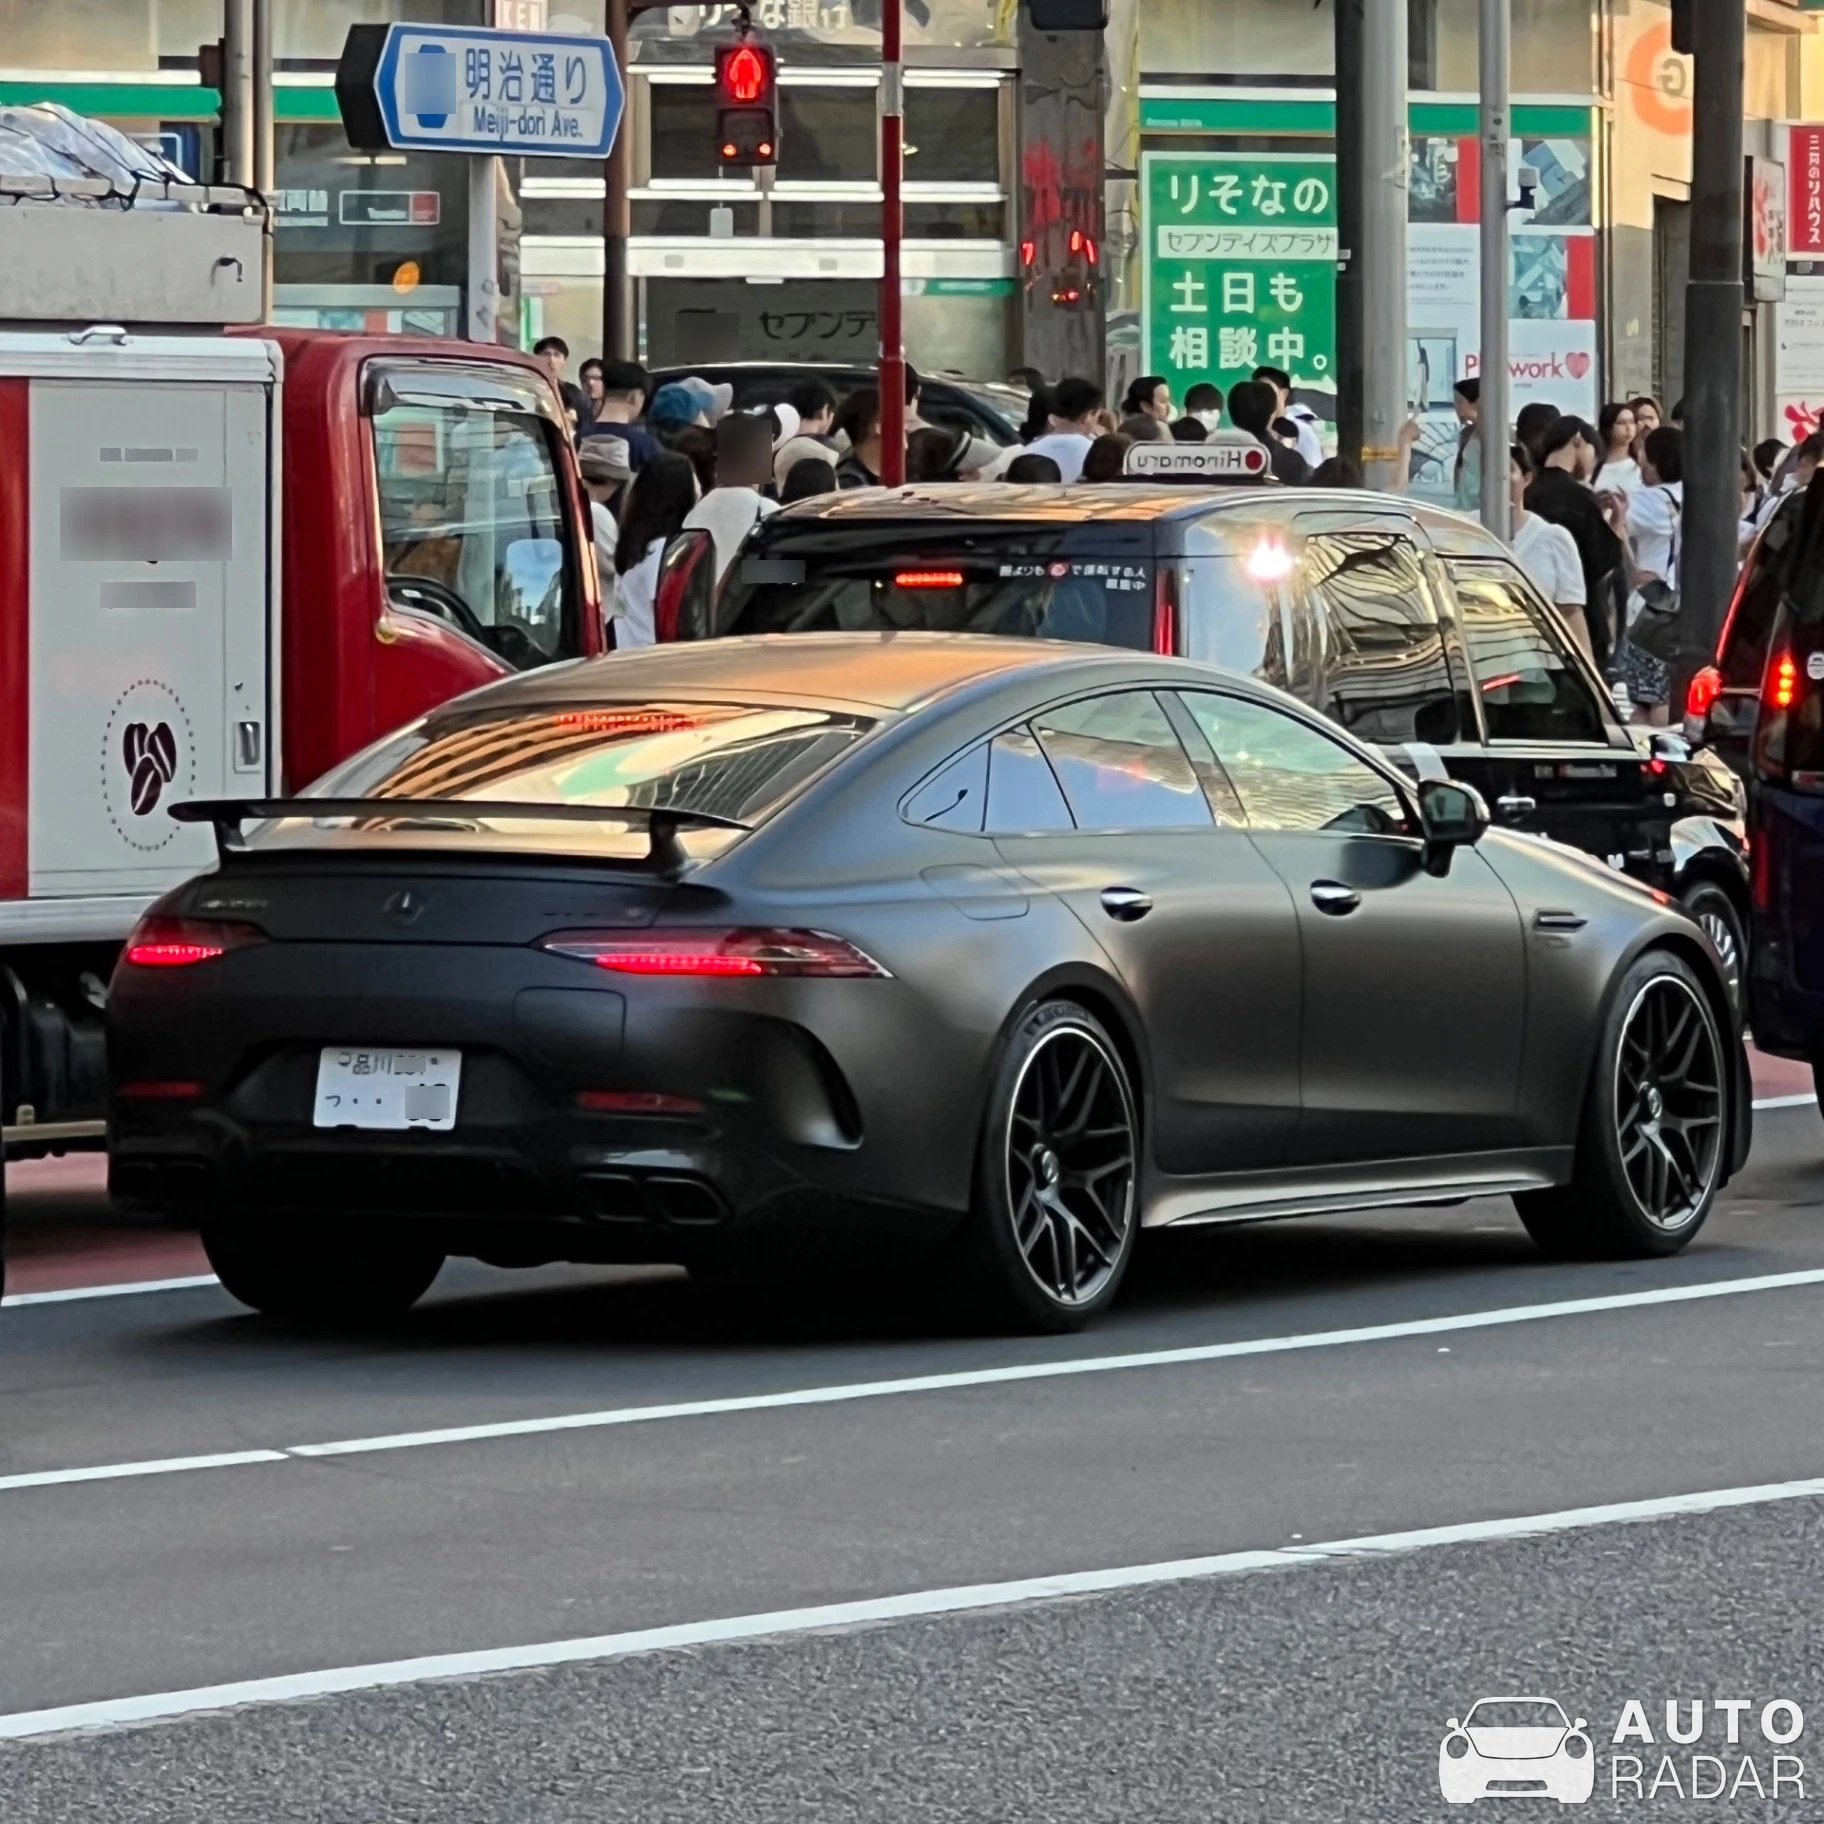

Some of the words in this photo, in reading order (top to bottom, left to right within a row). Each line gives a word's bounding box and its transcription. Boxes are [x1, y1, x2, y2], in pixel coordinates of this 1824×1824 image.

[466, 48, 586, 104] 明治通り
[473, 105, 546, 136] Meiji-dori
[551, 110, 583, 138] Ave.
[1170, 174, 1329, 215] りそなの
[1170, 271, 1303, 313] 土日も
[1169, 326, 1328, 370] 相談中。
[353, 1054, 393, 1076] 品川
